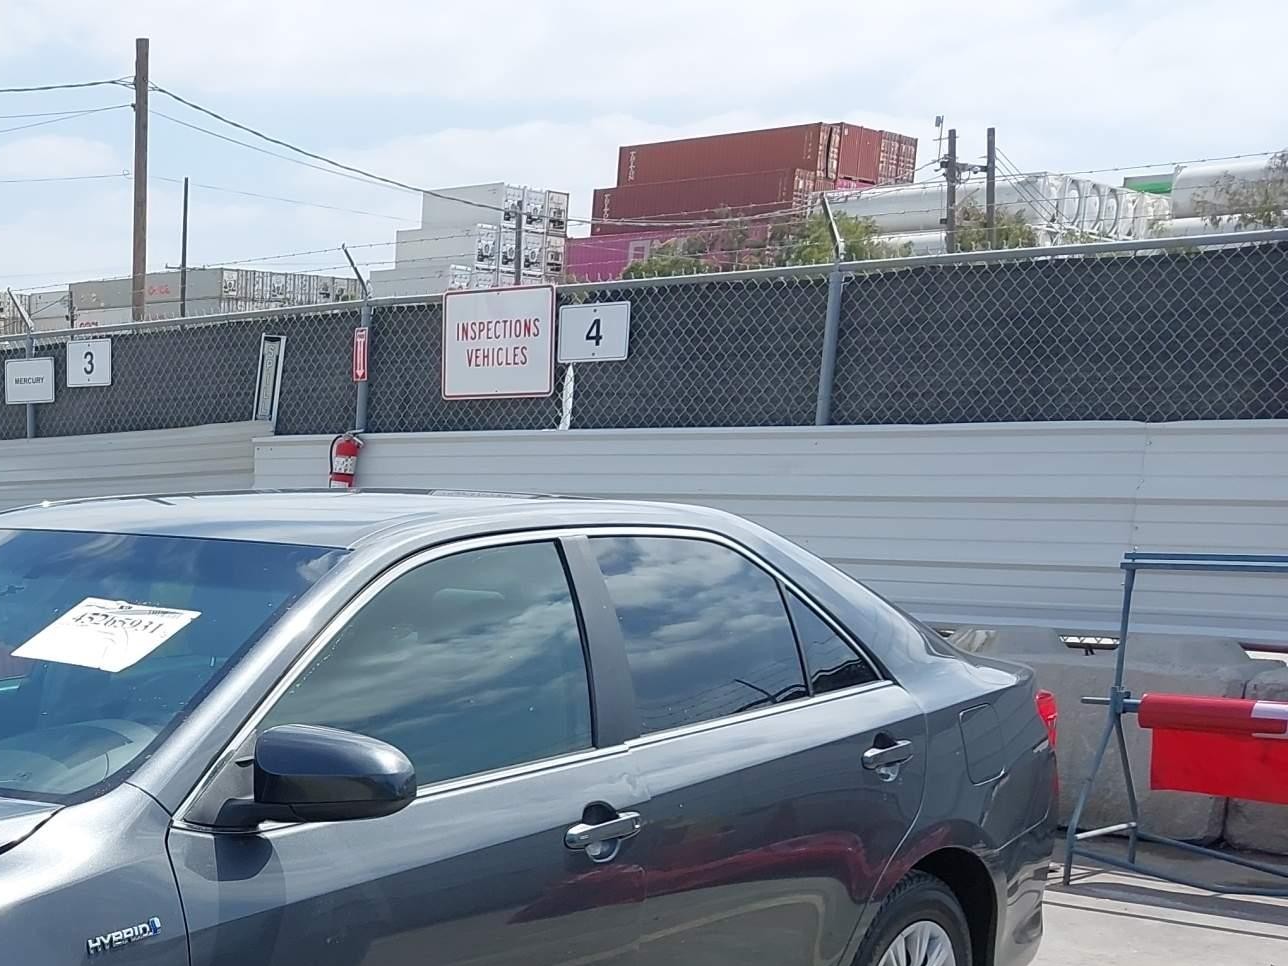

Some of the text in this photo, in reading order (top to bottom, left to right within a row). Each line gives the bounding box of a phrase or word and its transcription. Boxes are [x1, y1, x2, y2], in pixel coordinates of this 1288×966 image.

[456, 317, 540, 341] INSPECTIONS
[585, 318, 603, 347] 4
[83, 351, 94, 375] 3
[466, 346, 528, 368] VEHICLES
[14, 376, 45, 385] MERCURY
[87, 922, 153, 955] HYBRID
